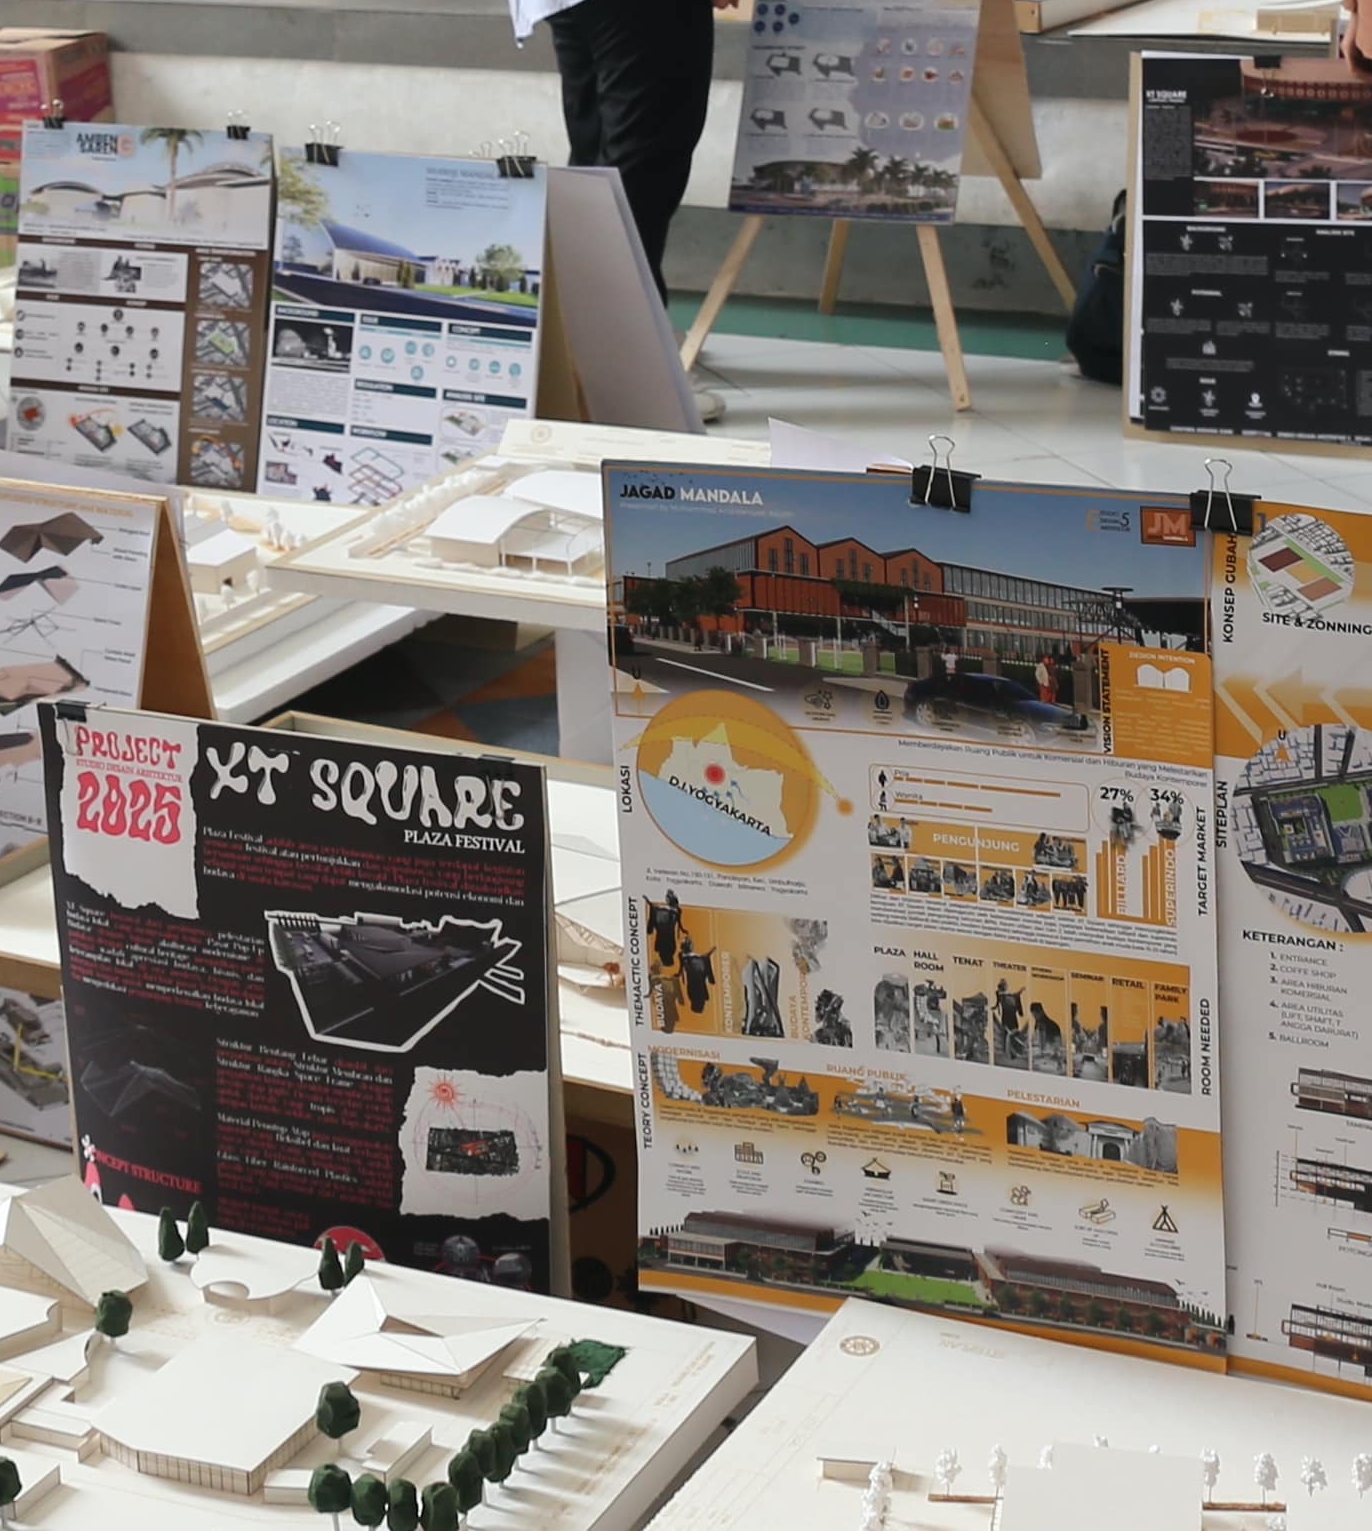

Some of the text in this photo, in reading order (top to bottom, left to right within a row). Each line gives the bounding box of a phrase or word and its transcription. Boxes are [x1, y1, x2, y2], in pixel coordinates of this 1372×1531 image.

[619, 484, 764, 506] JAGAD MANDALA
[1148, 512, 1186, 535] JM
[1222, 586, 1235, 643] KONSEP
[1263, 612, 1372, 635] SITE & ZONNING
[1100, 649, 1113, 754] VISION STATEMENT
[75, 726, 181, 769] PROJECT
[991, 748, 1017, 758] Publik
[1103, 759, 1136, 770] Hiburan
[1138, 762, 1157, 773] yang
[206, 742, 524, 830] XT SQUARE
[621, 765, 632, 813] LOKASI
[1100, 787, 1134, 804] 27%
[1151, 788, 1184, 805] 34%
[76, 771, 181, 845] 2025
[1215, 780, 1228, 848] SITEPLAN
[404, 830, 525, 854] PLAZA FESTIVAL
[932, 833, 1020, 853] PENGUNJUNG
[1195, 807, 1209, 916] TARGET MARKET
[1116, 854, 1127, 915] BILLIARD
[1166, 849, 1177, 926] SUPERINDO
[629, 897, 640, 955] CONCEPT
[1242, 930, 1336, 951] KETERANGAN
[874, 946, 906, 958] PLAZA
[913, 950, 939, 961] HALL
[953, 956, 983, 968] TENAT
[1280, 953, 1328, 966] ENTRANCE
[914, 961, 945, 972] ROOM
[1071, 972, 1104, 982] SEMINAR
[1112, 978, 1145, 989] RETAIL
[1154, 983, 1188, 995] FAMILY
[1281, 978, 1304, 988] AREA
[1154, 994, 1180, 1004] PARK
[1281, 1001, 1343, 1018] AREA UTILITAS
[1281, 1020, 1308, 1031] ANGGA
[1200, 998, 1212, 1096] ROOM NEEDED
[1279, 1034, 1329, 1049] BALLROOM
[647, 1045, 721, 1060] MODERNISASI
[826, 1064, 907, 1081] RUANG PUBLIK
[638, 1053, 652, 1149] TEORY CONCEPT
[1007, 1089, 1080, 1108] PELESTARIAN
[131, 1165, 202, 1194] STRUCTURE
